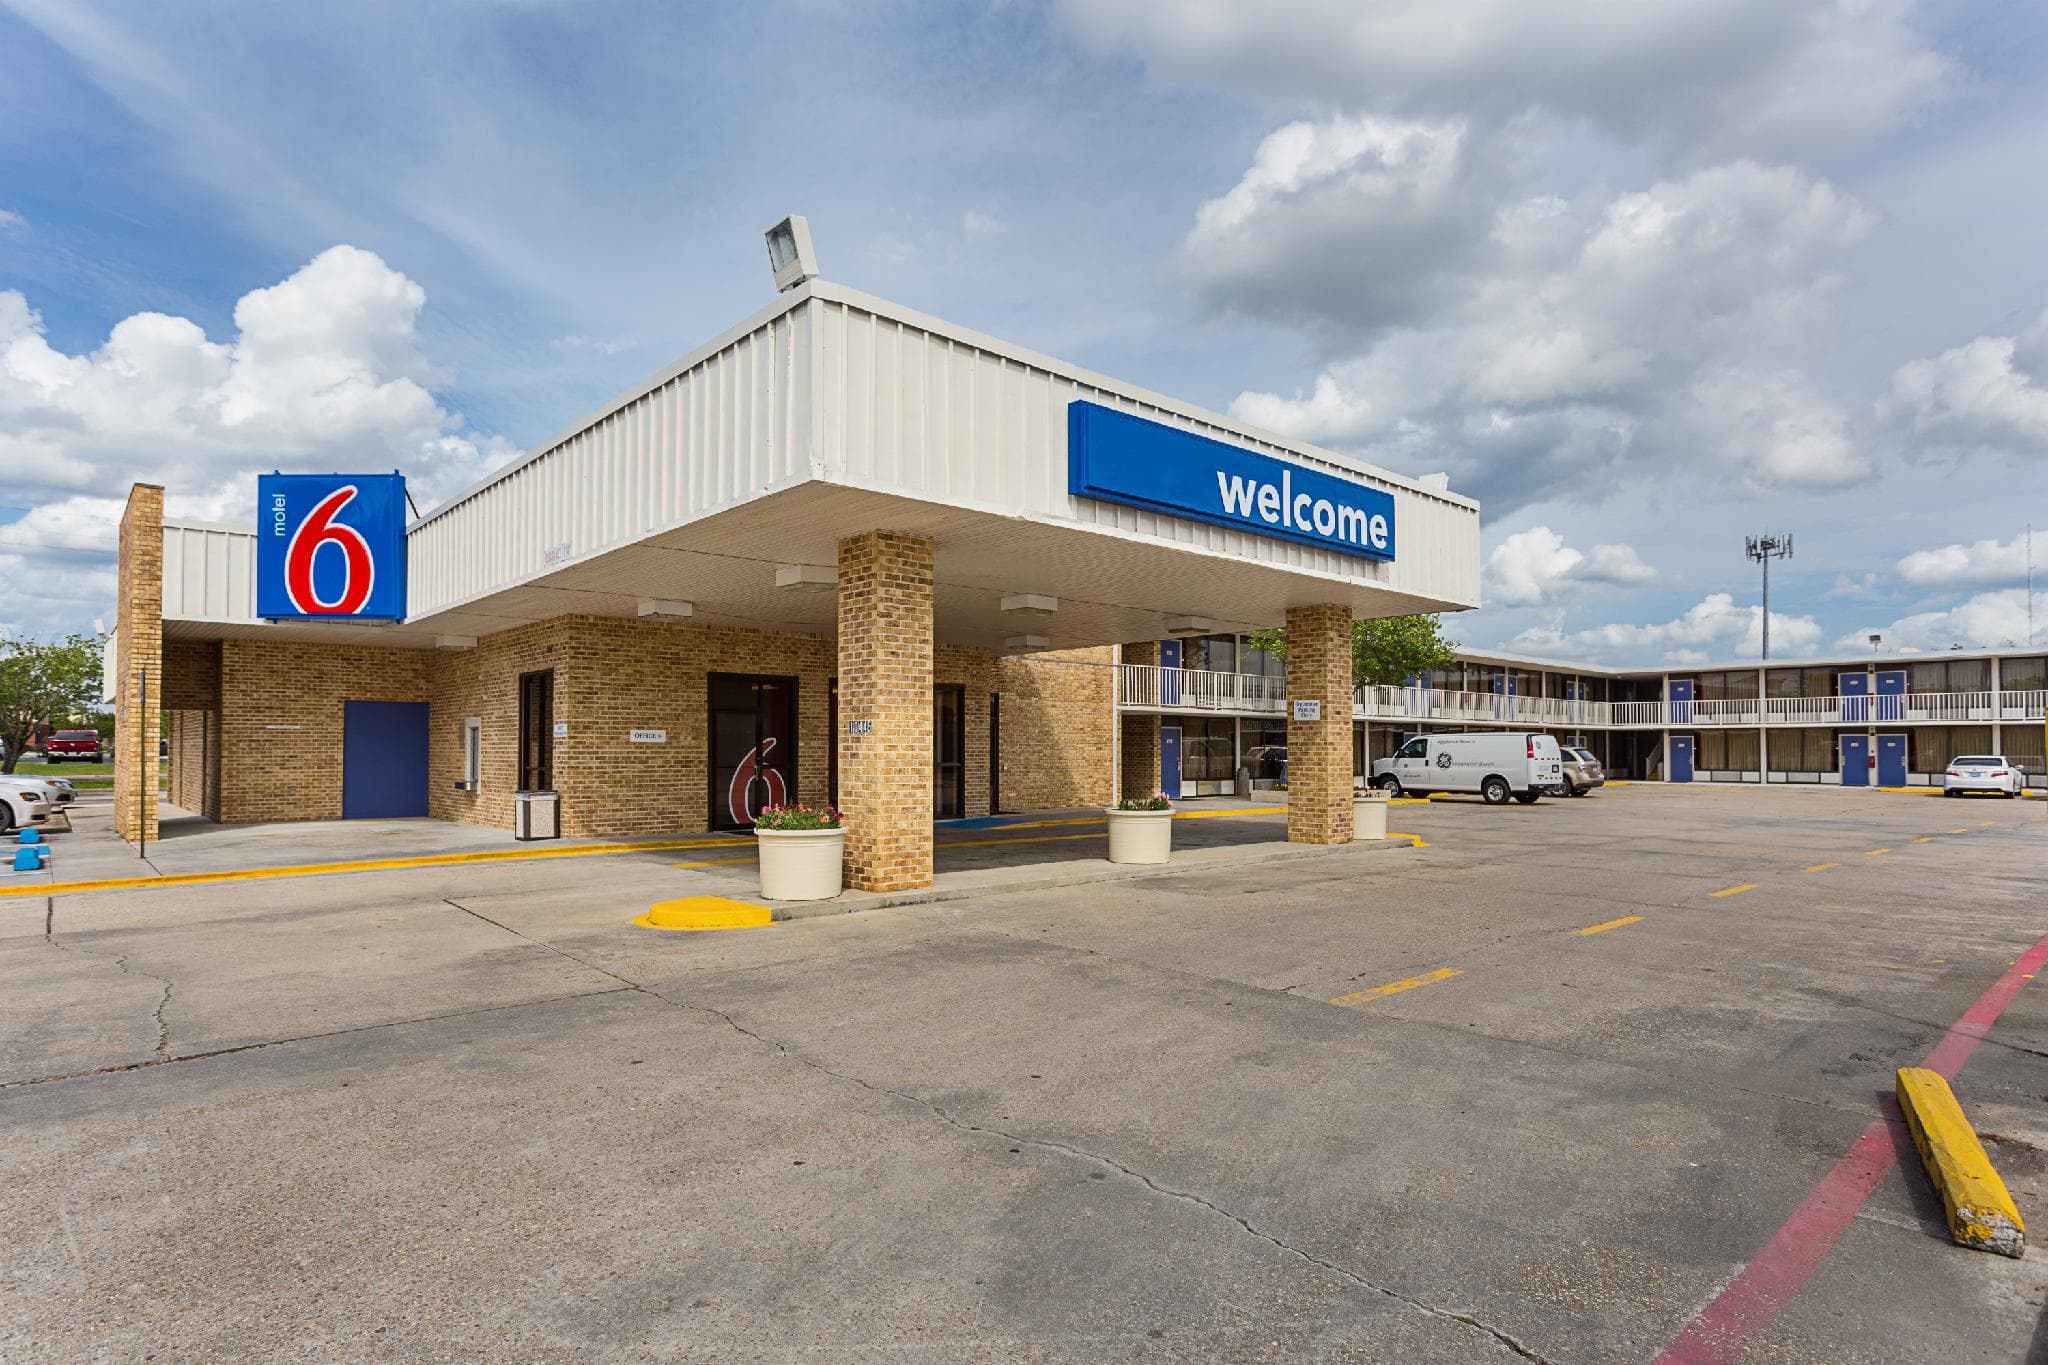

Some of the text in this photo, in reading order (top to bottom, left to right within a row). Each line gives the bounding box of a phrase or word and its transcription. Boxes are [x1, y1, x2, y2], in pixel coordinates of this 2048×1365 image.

[271, 484, 376, 615] motel 6
[1216, 469, 1388, 549] welcome
[728, 737, 787, 825] 6
